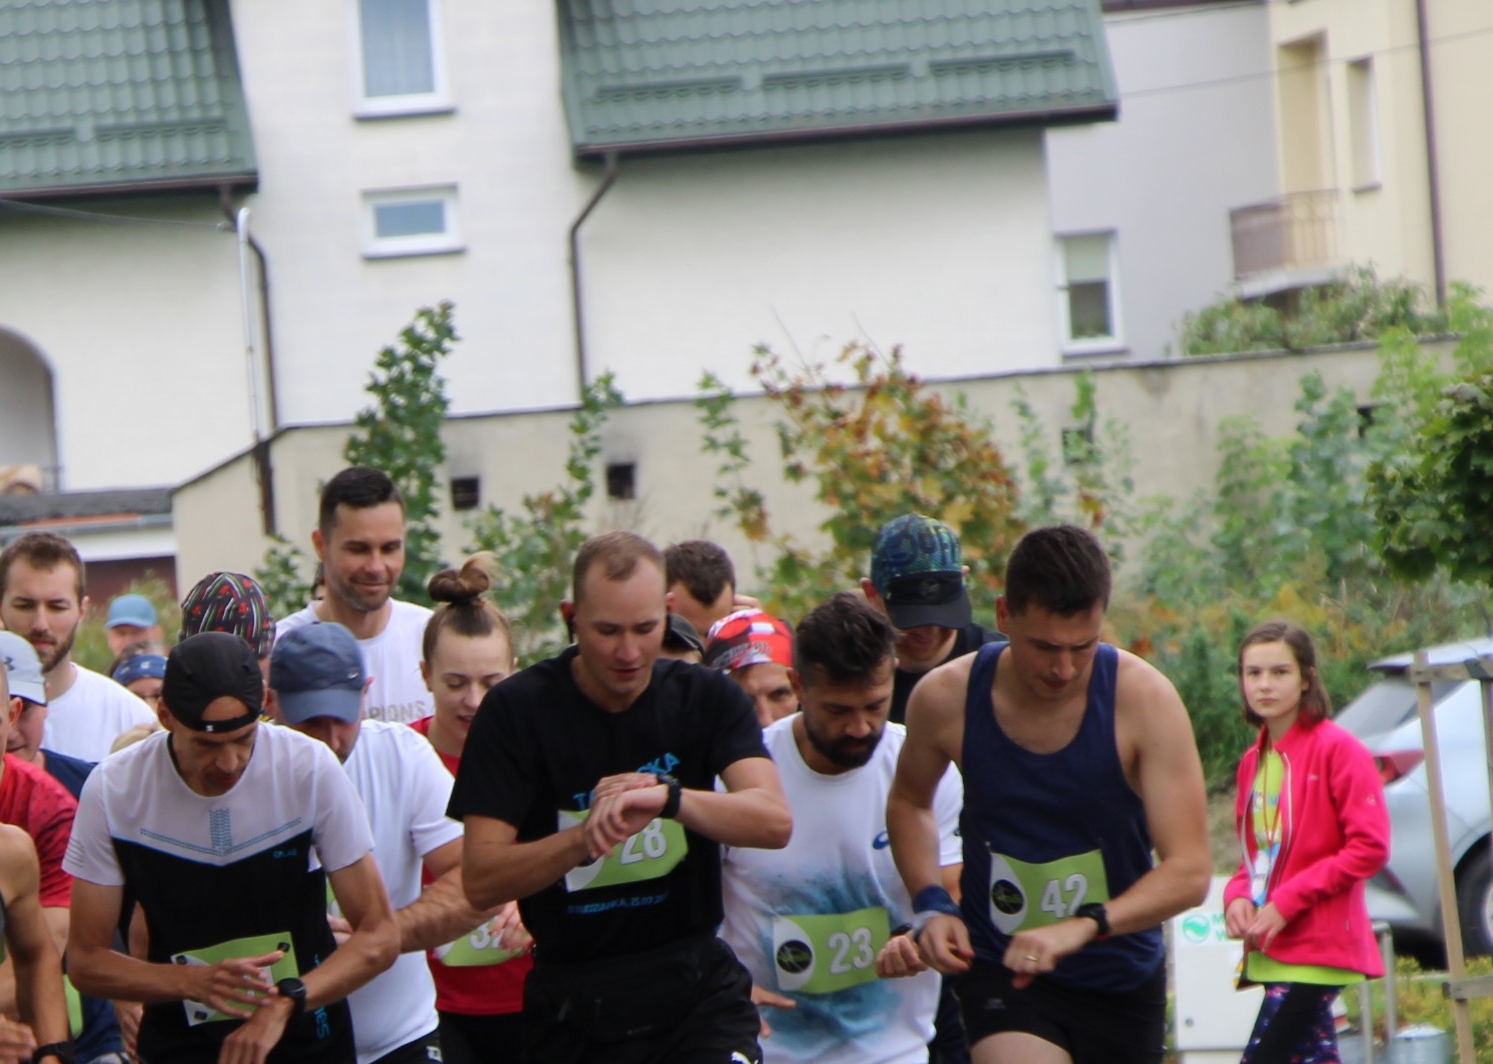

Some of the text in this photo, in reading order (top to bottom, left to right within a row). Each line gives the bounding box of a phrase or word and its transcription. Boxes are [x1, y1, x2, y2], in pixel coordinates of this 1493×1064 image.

[368, 700, 426, 723] PIONS
[620, 817, 668, 866] 28
[1040, 873, 1089, 919] 42
[827, 926, 875, 975] 23
